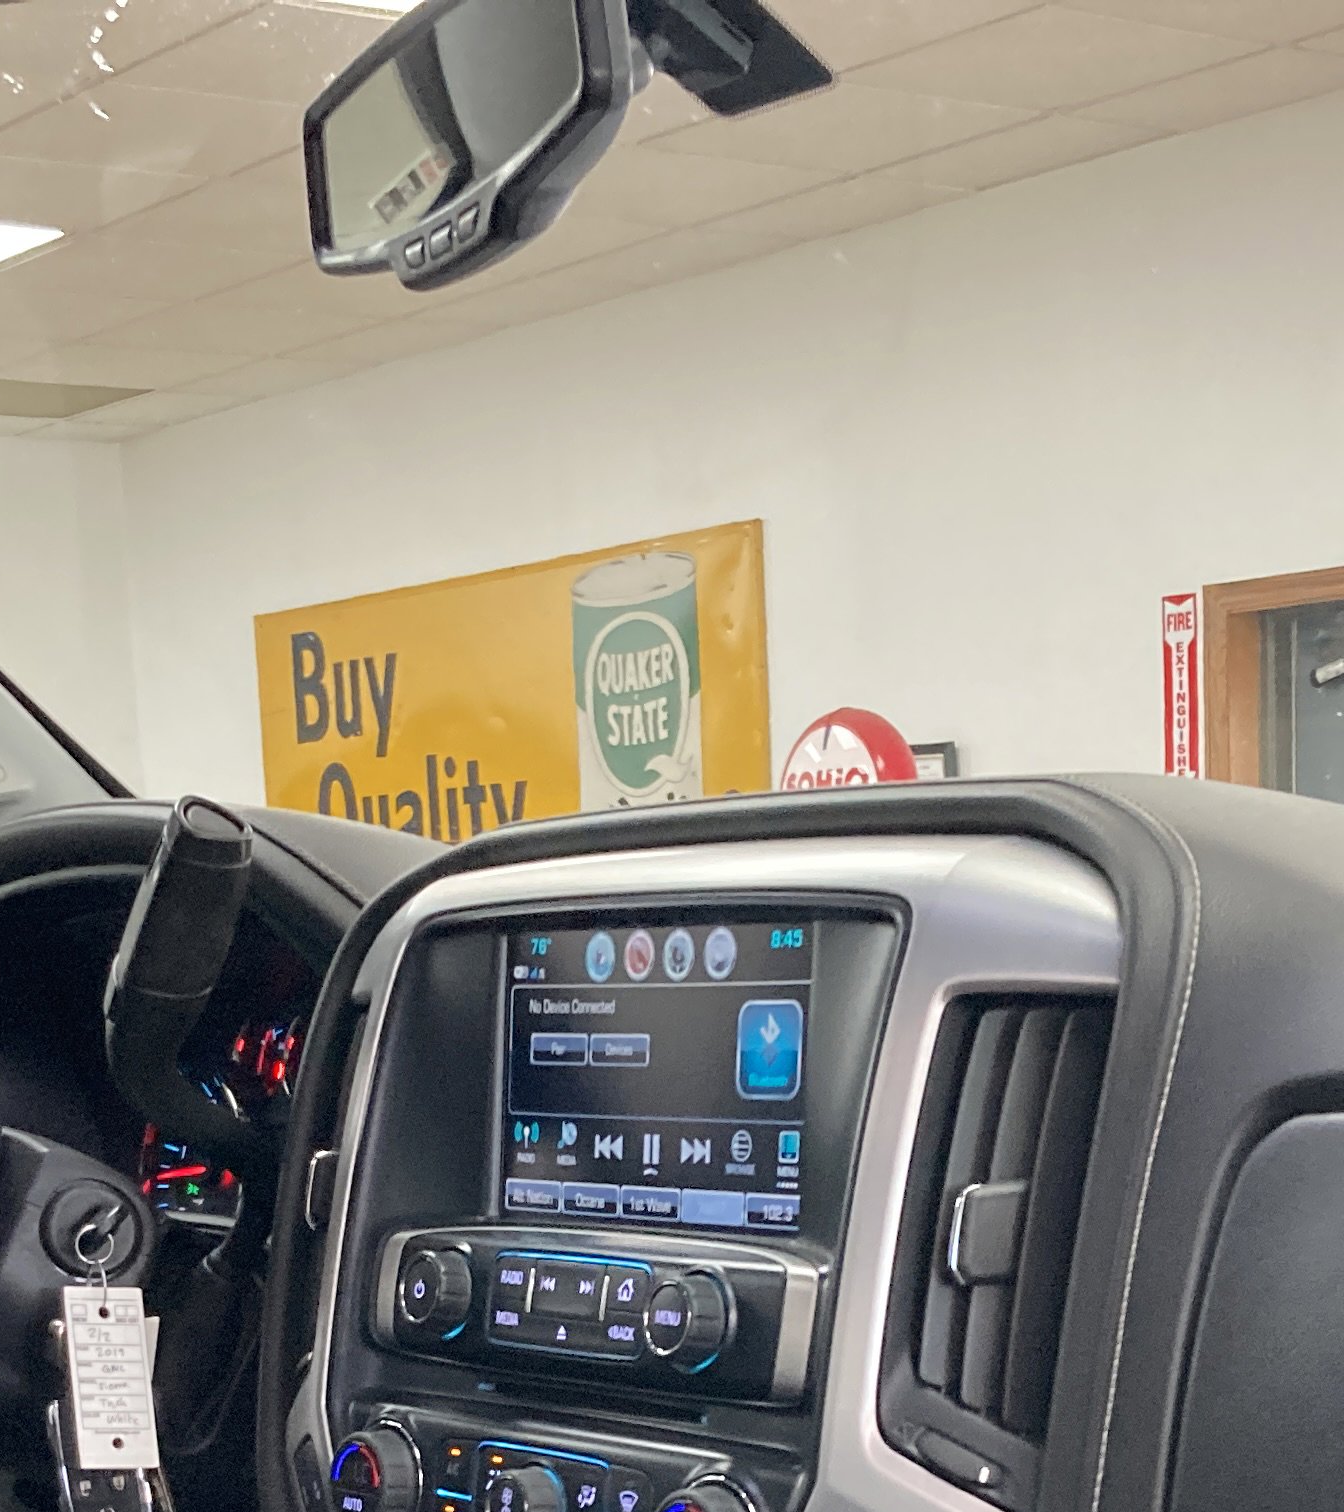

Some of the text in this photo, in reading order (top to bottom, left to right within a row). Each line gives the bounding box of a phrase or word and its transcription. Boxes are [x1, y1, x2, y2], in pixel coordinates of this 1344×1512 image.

[1166, 611, 1193, 633] FIRE
[598, 643, 675, 696] QUAKER
[291, 632, 397, 756] Buy
[606, 696, 670, 747] STATE
[770, 928, 803, 949] 8:45
[529, 997, 616, 1015] No Device Connected
[342, 1496, 363, 1512] AUTO
